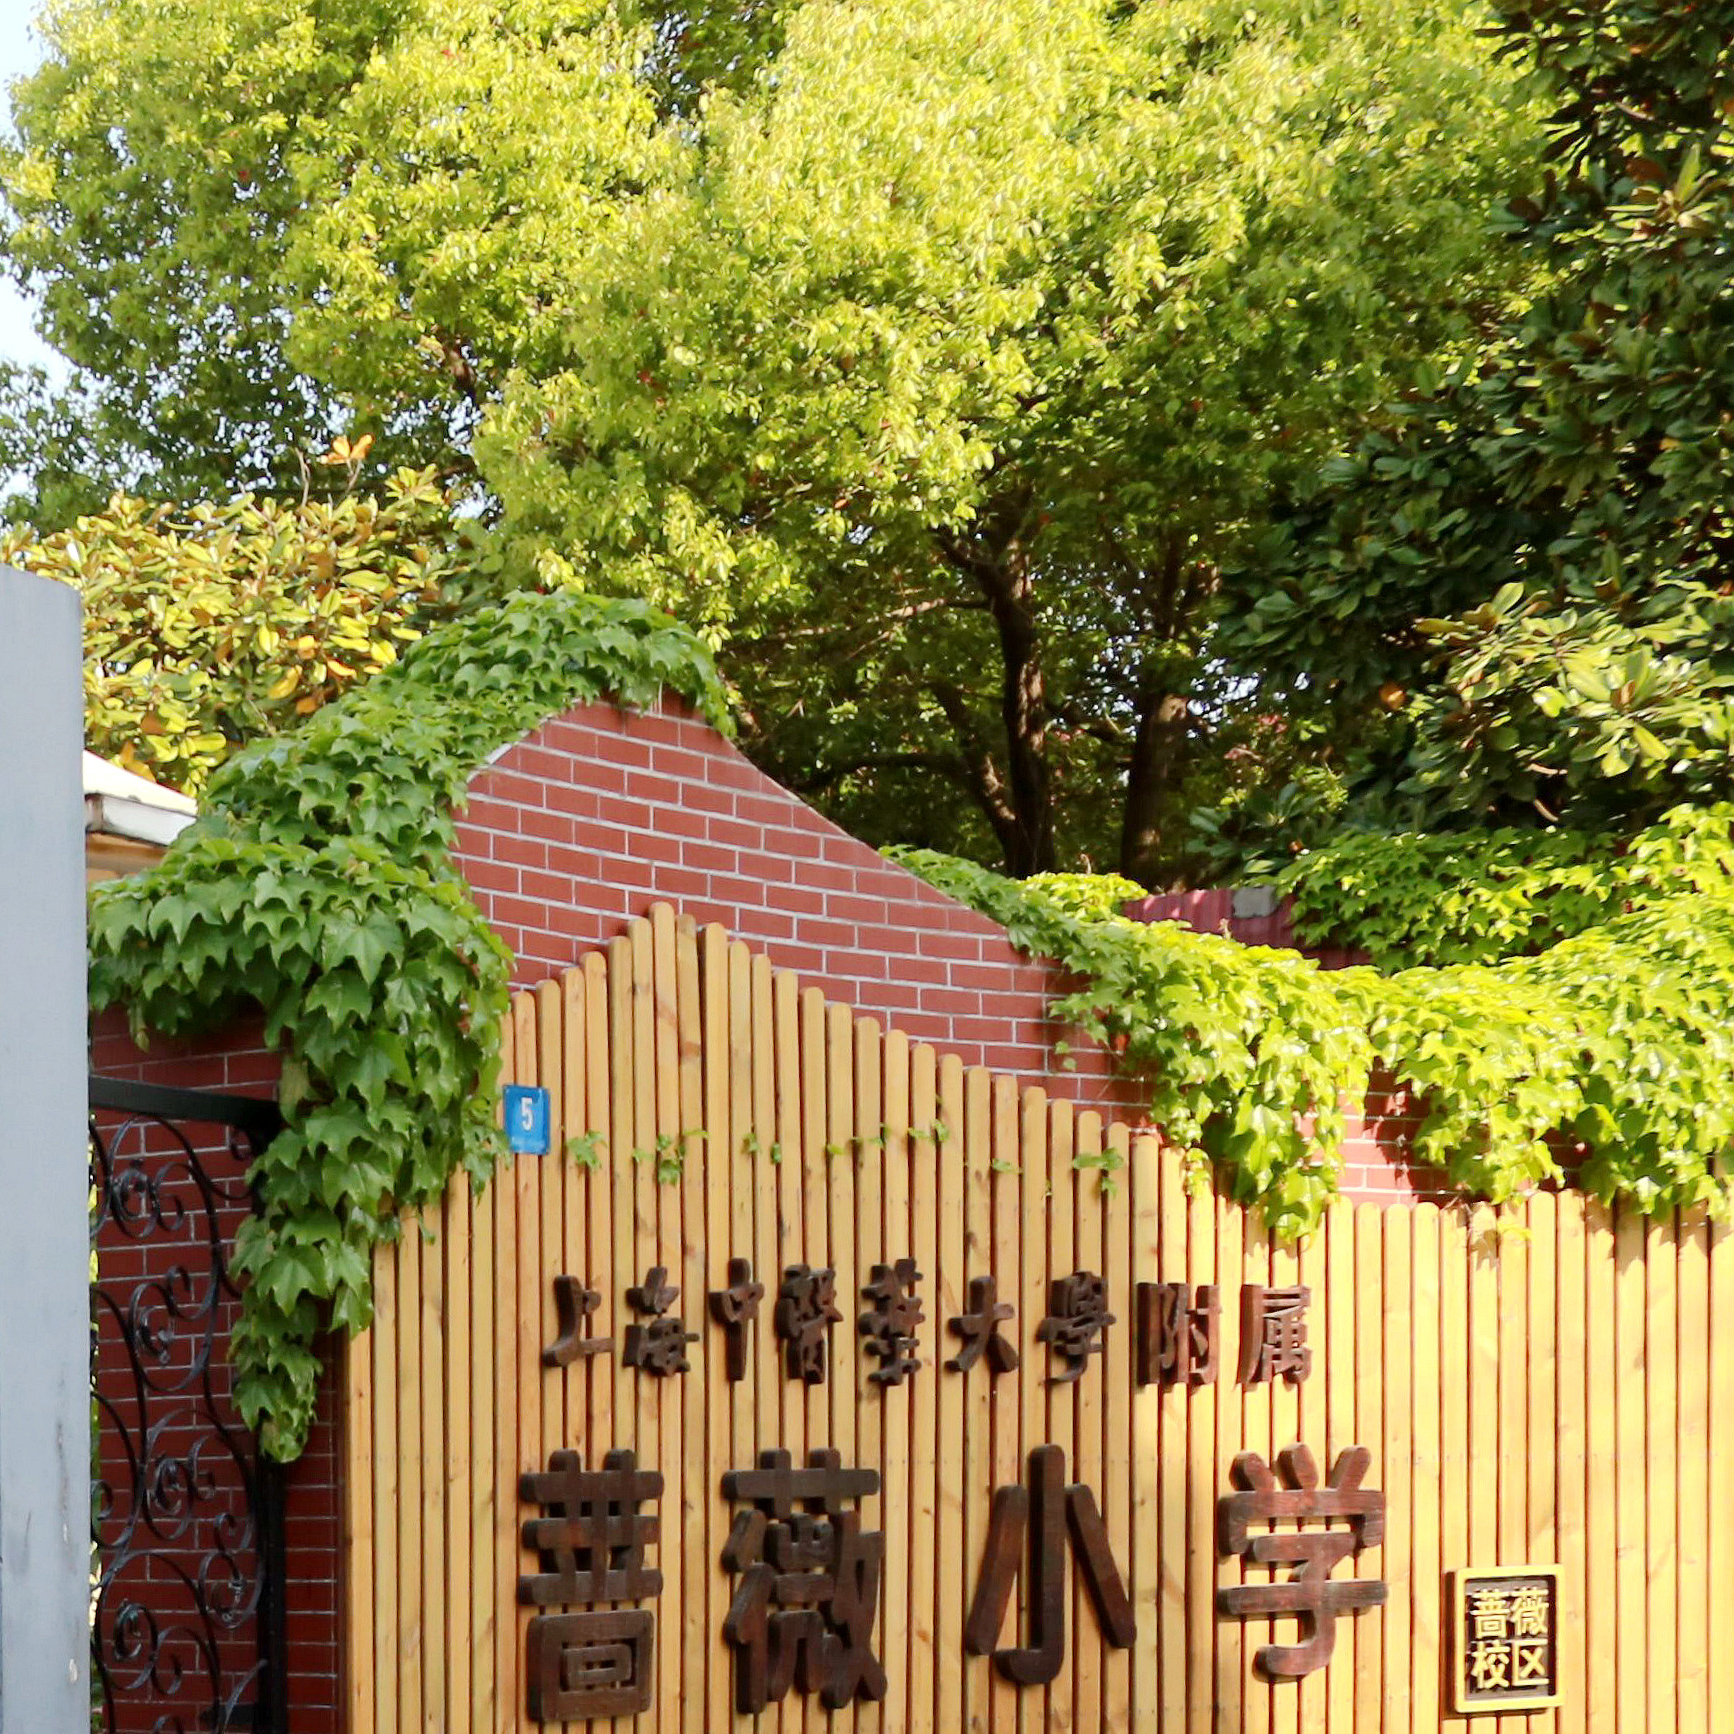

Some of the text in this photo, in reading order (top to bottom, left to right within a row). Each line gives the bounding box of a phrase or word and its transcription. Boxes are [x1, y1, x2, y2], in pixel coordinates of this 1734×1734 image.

[521, 1096, 534, 1131] 5
[517, 1443, 1389, 1722] 蔷薇小学
[1470, 1587, 1550, 1639] 蔷薇
[1470, 1639, 1550, 1689] 校区
